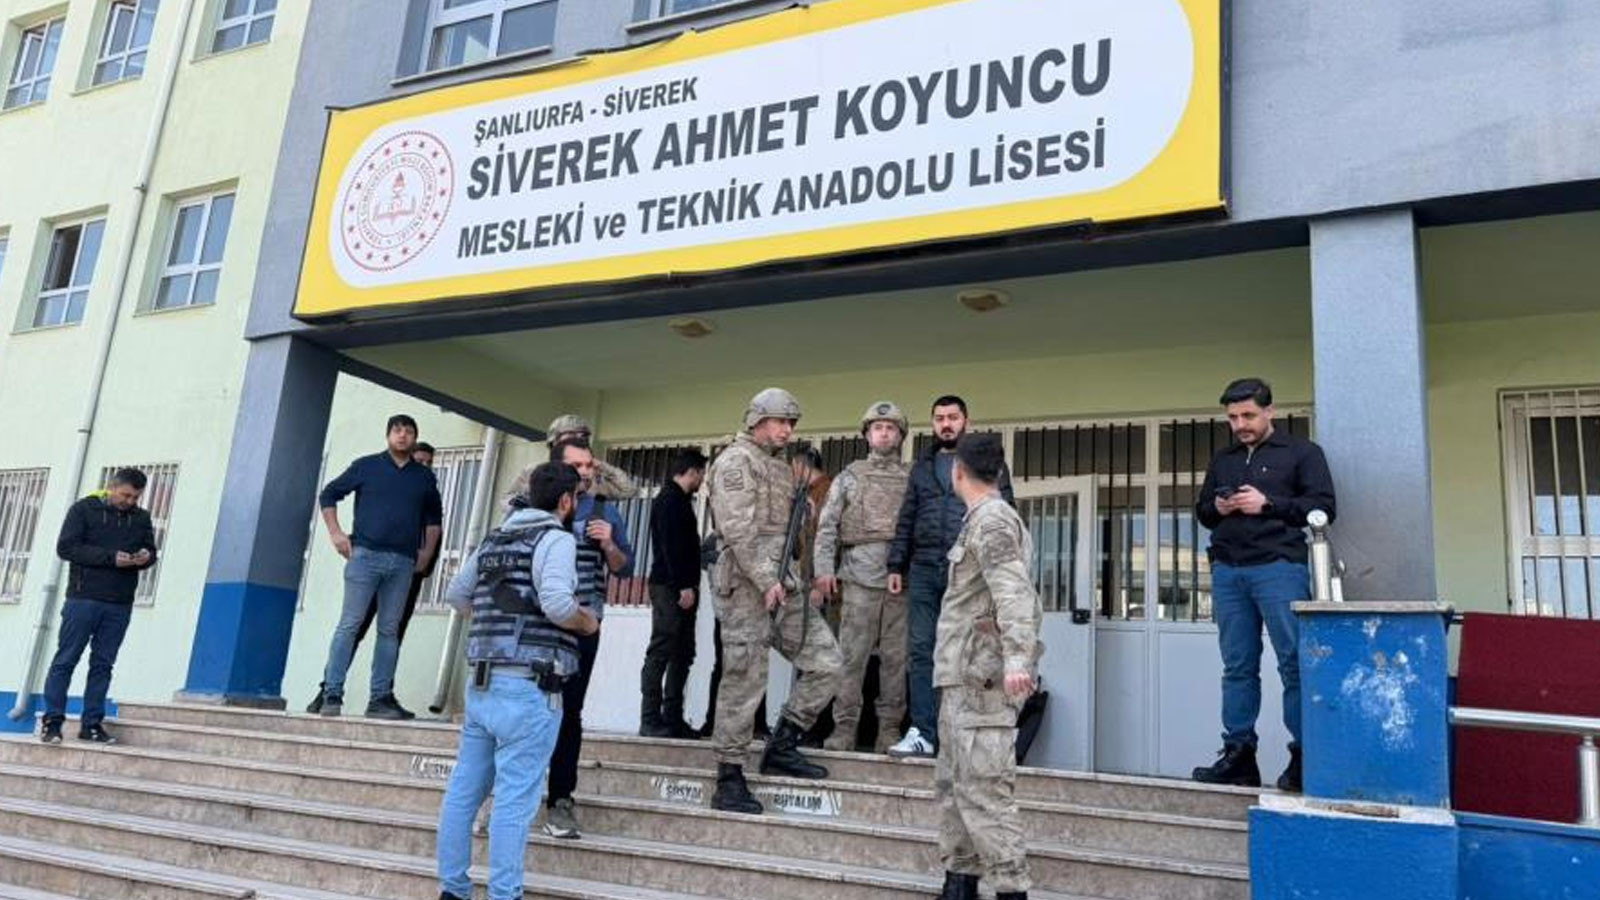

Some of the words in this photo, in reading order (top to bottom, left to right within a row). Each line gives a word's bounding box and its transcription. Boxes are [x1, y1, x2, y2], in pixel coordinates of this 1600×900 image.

[466, 129, 643, 200] SİVEREK
[652, 95, 820, 171] AHMET
[834, 38, 1112, 140] KOYUNCU
[474, 100, 584, 147] ŞANLIURFA
[602, 77, 698, 117] SİVEREK
[457, 202, 584, 259] MESLEKİ
[594, 212, 627, 240] ve
[637, 178, 763, 234] TEKNİK
[771, 152, 955, 216] ANADOLU
[969, 117, 1106, 188] LİSESİ
